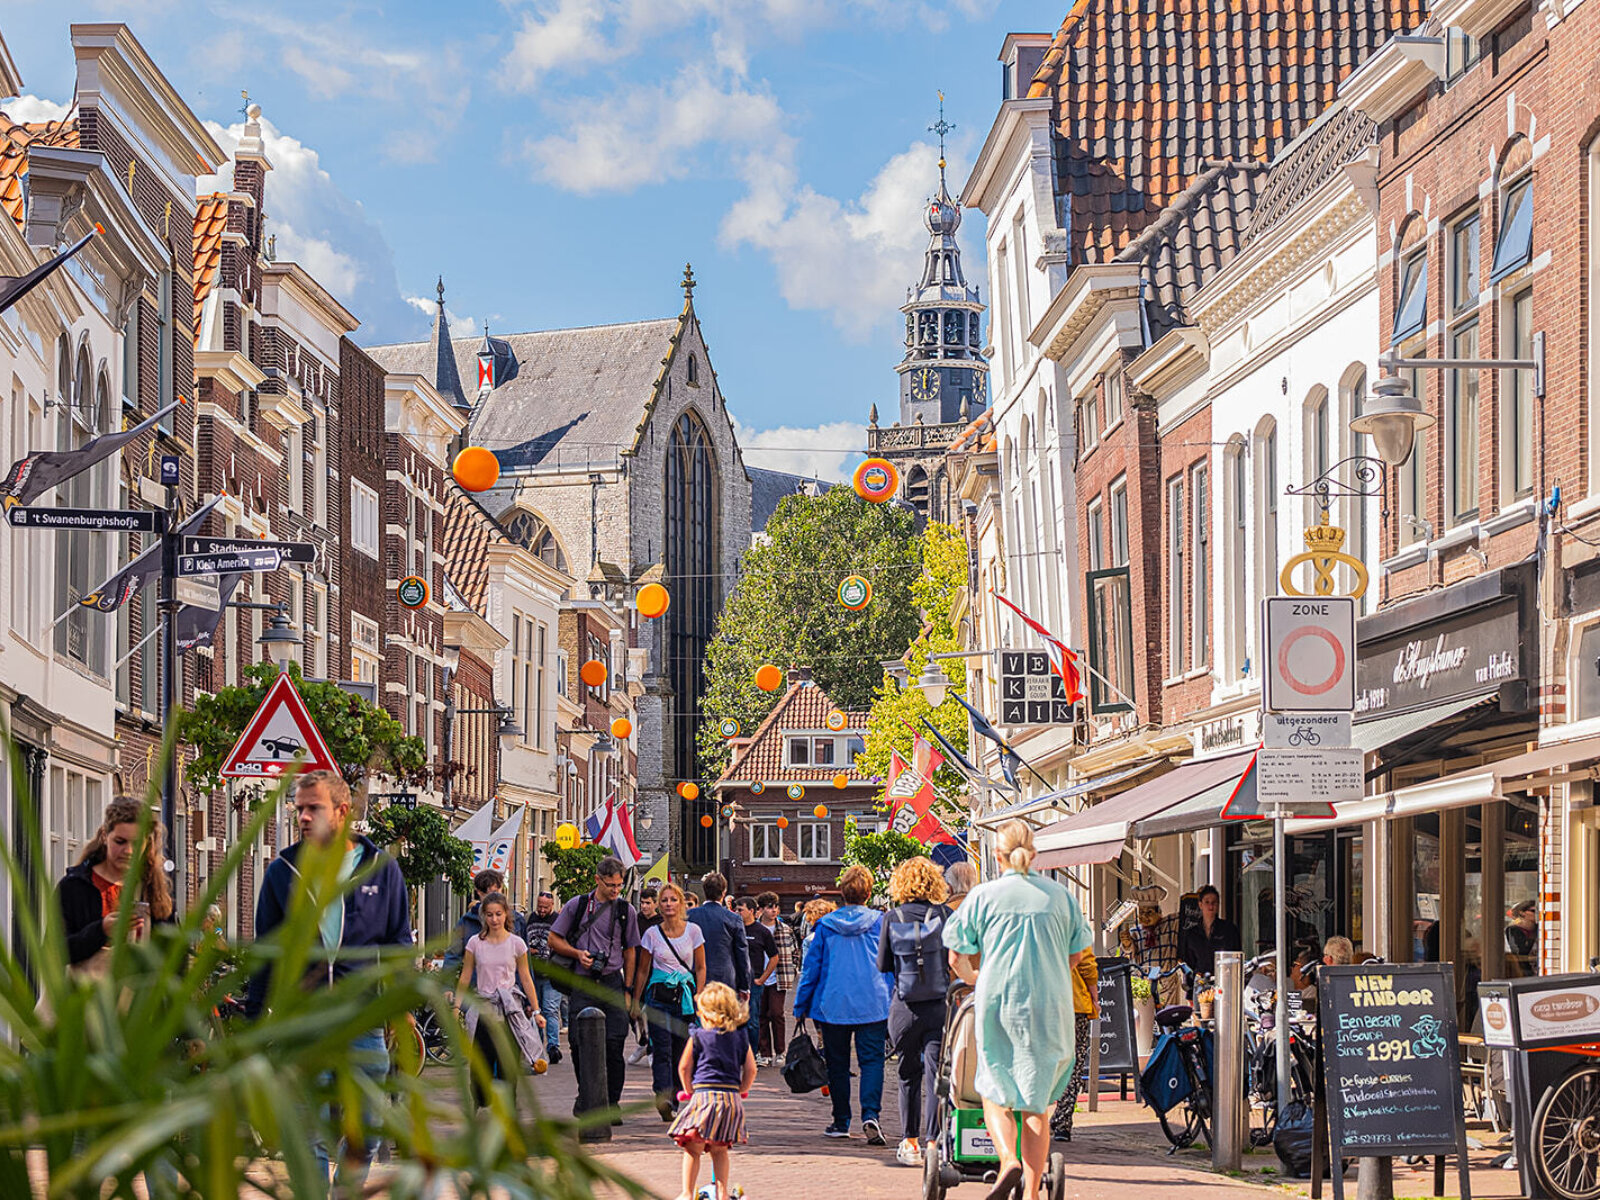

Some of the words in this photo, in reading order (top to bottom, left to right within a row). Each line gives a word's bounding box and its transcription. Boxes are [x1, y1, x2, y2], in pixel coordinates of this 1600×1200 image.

[42, 513, 140, 529] Swanenburghshofje
[196, 558, 216, 570] Klein
[216, 557, 249, 569] Amerika
[1292, 604, 1329, 616] ZONE
[1276, 715, 1339, 727] uitgezonderd
[1354, 974, 1393, 992] NEW
[1349, 988, 1435, 1007] TANDOOR
[1338, 1013, 1364, 1029] Een
[1366, 1039, 1416, 1062] 1991
